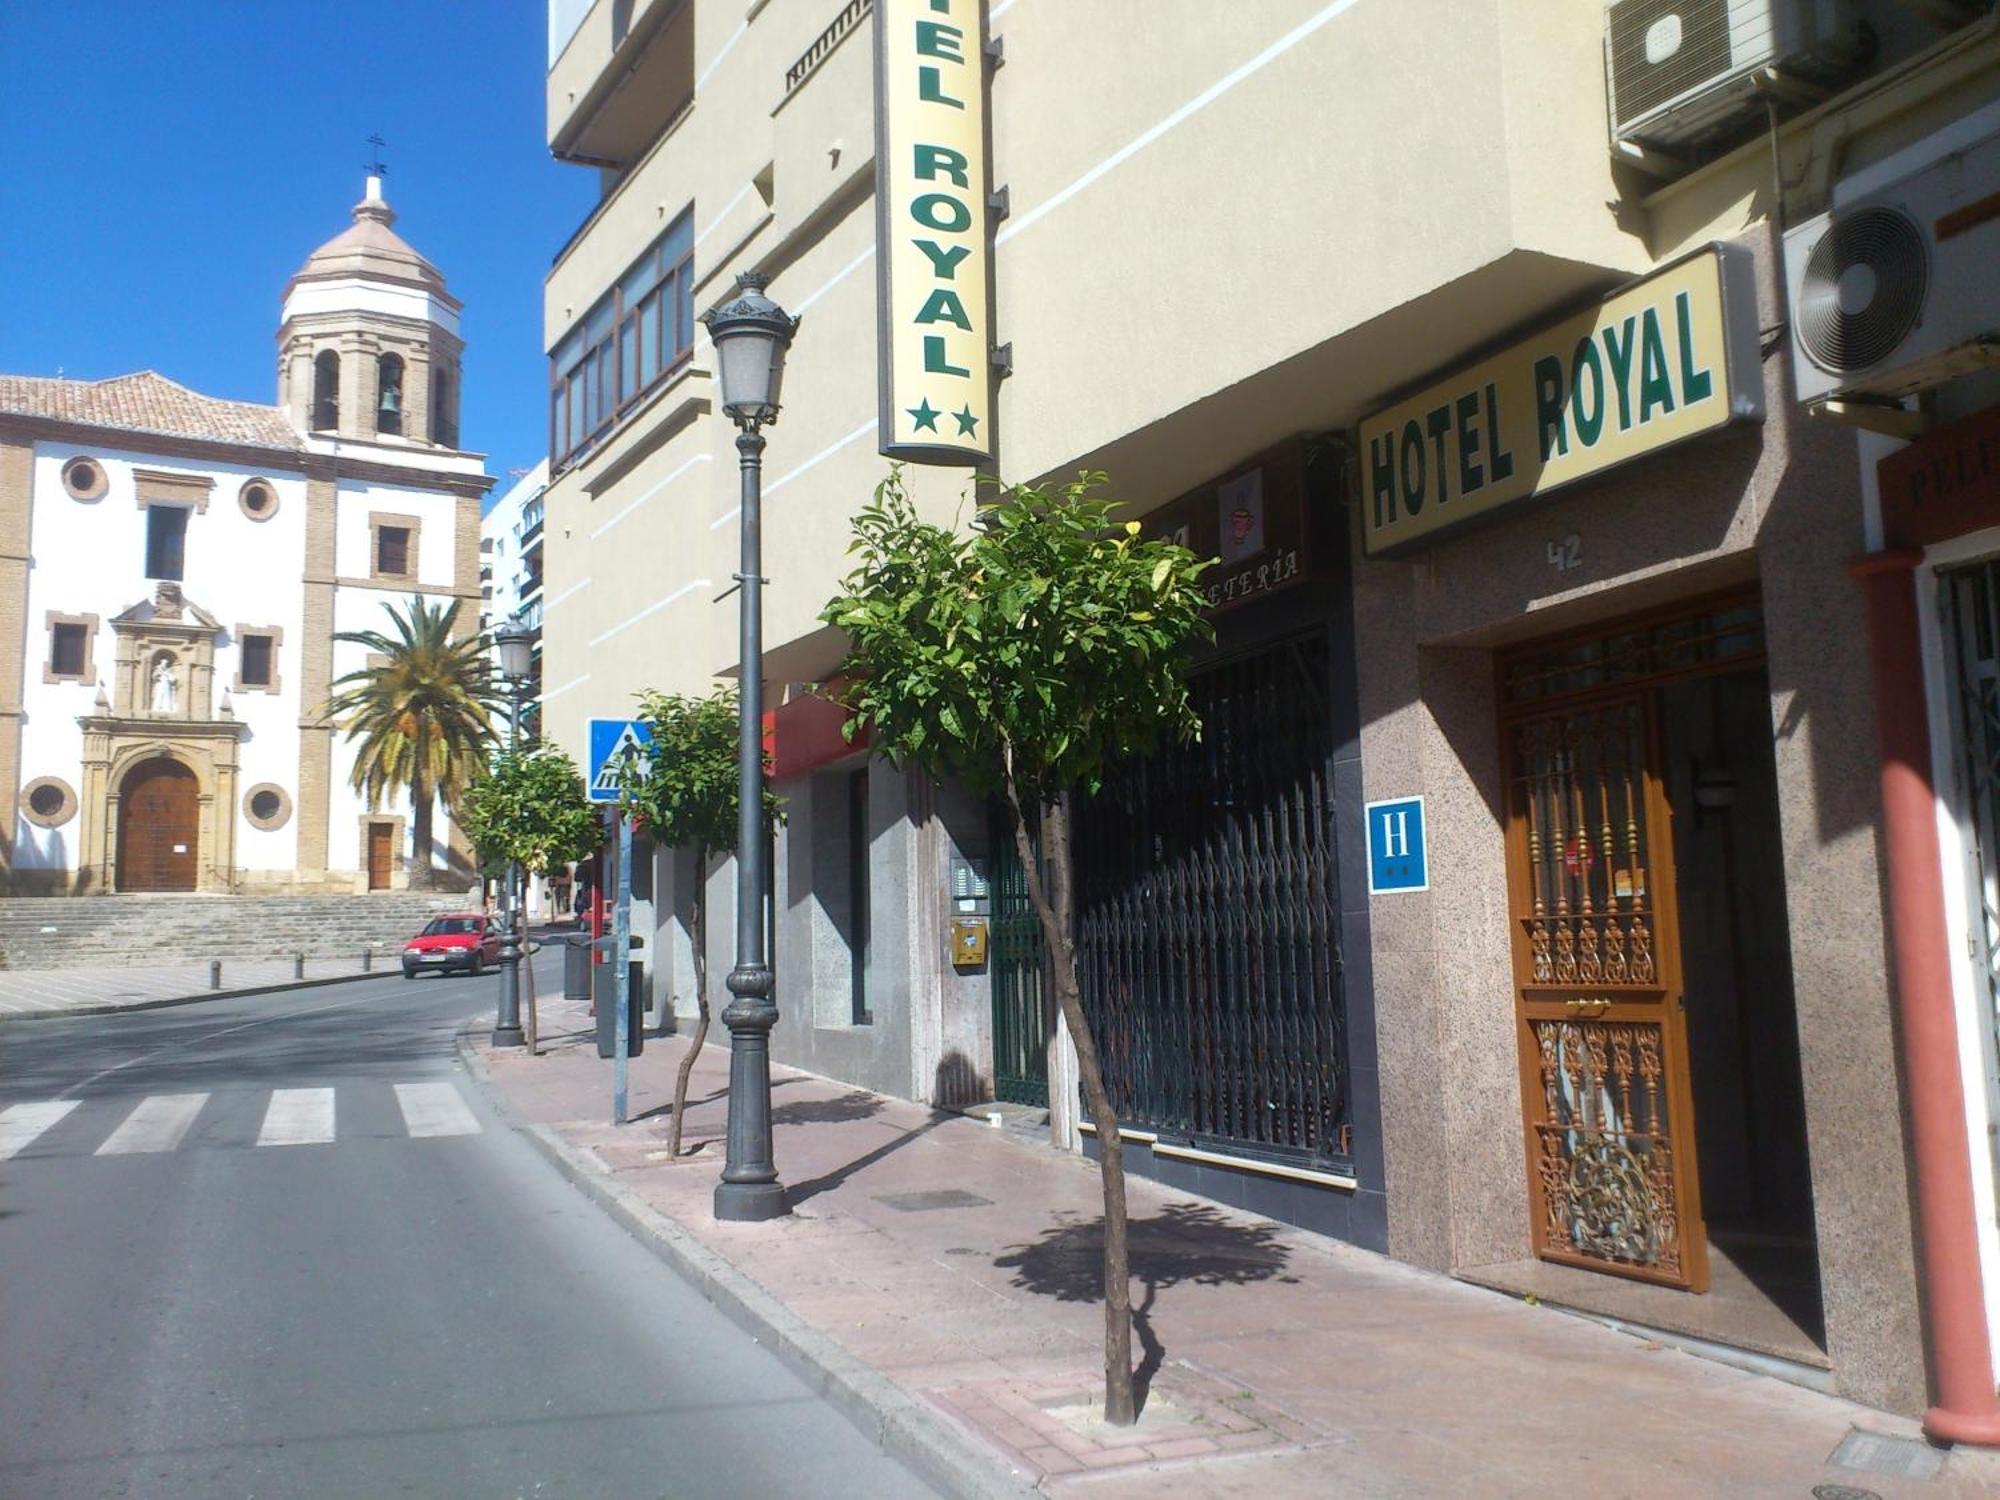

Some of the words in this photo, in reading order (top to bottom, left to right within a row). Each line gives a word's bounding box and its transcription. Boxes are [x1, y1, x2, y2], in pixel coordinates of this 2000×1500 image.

[910, 143, 974, 379] ROYAL
[1370, 382, 1514, 530] HOTEL
[1533, 290, 1713, 464] ROYAL
[1199, 549, 1300, 607] ETERÍA
[1547, 535, 1583, 571] 42
[1381, 811, 1411, 858] H
